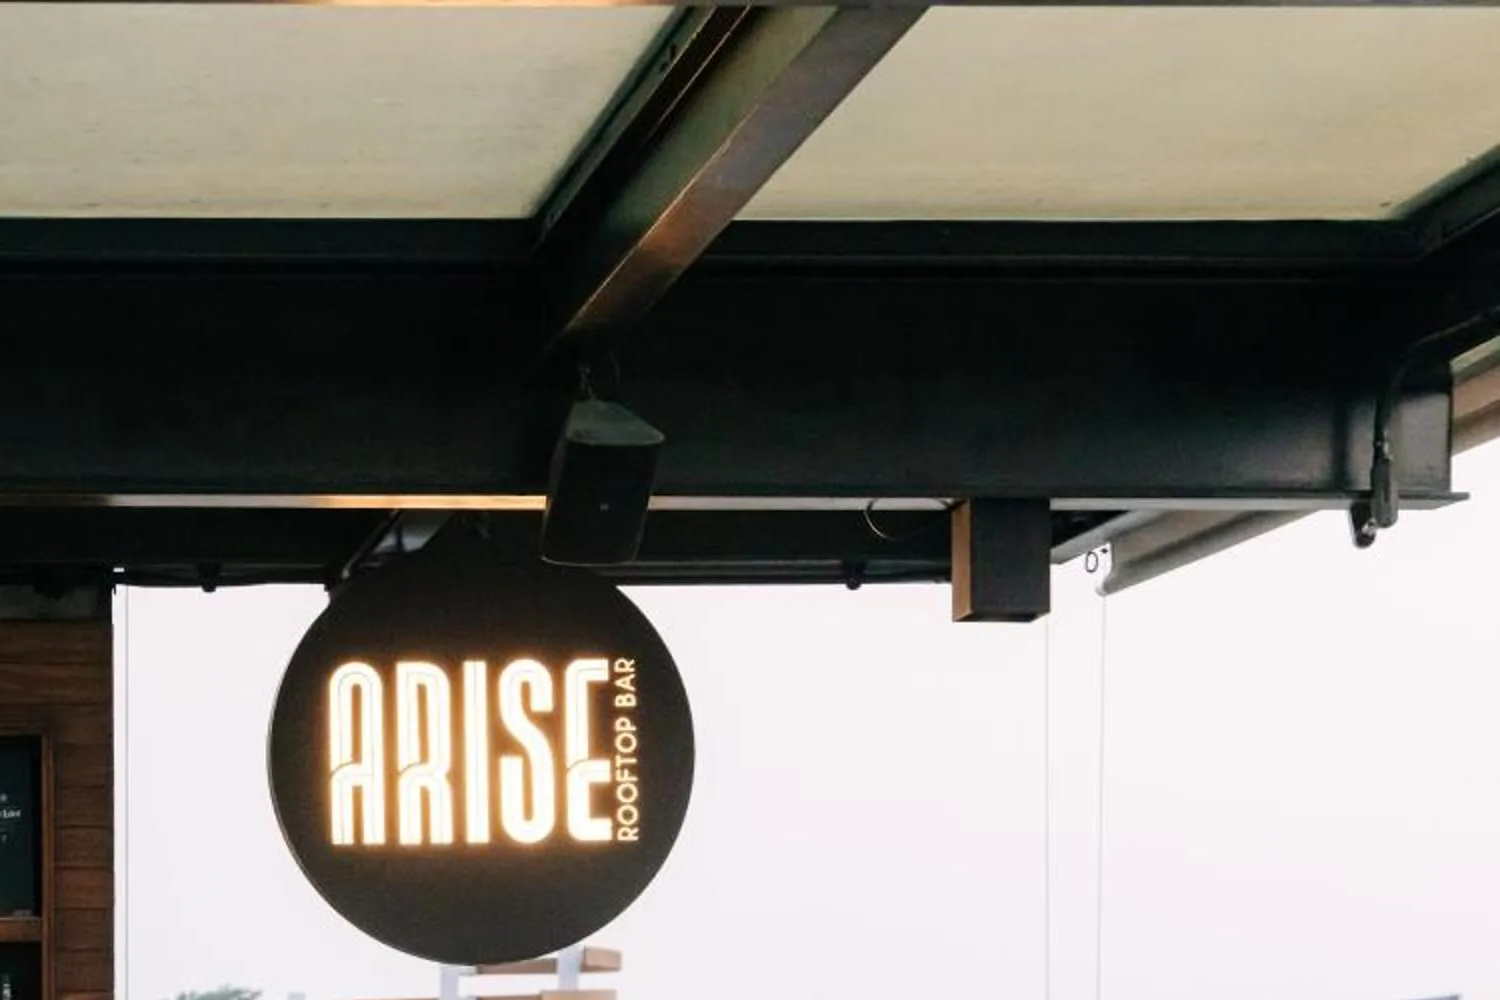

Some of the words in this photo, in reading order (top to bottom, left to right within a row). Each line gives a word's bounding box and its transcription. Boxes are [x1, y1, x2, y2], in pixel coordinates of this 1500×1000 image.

[613, 657, 637, 707] BAR
[329, 659, 612, 845] ARISE
[614, 717, 640, 841] ROOFTOP
